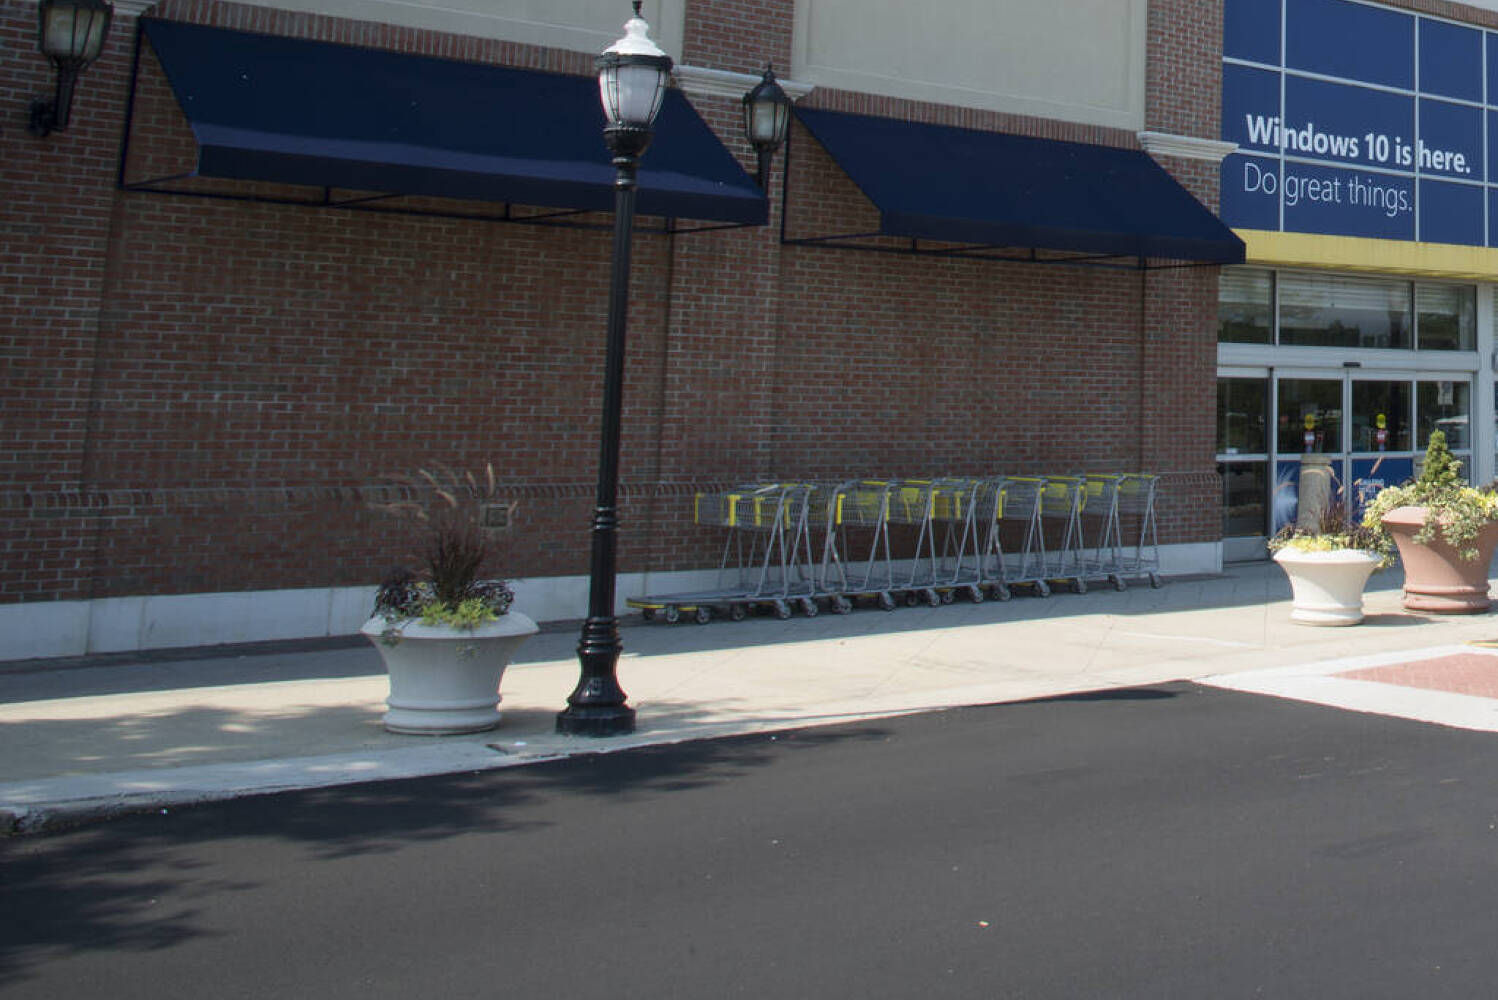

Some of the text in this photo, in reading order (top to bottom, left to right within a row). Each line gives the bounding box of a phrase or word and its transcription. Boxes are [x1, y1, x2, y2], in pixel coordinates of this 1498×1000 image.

[1246, 114, 1471, 174] Windows 10 is here.
[1244, 162, 1413, 217] Do great things.
